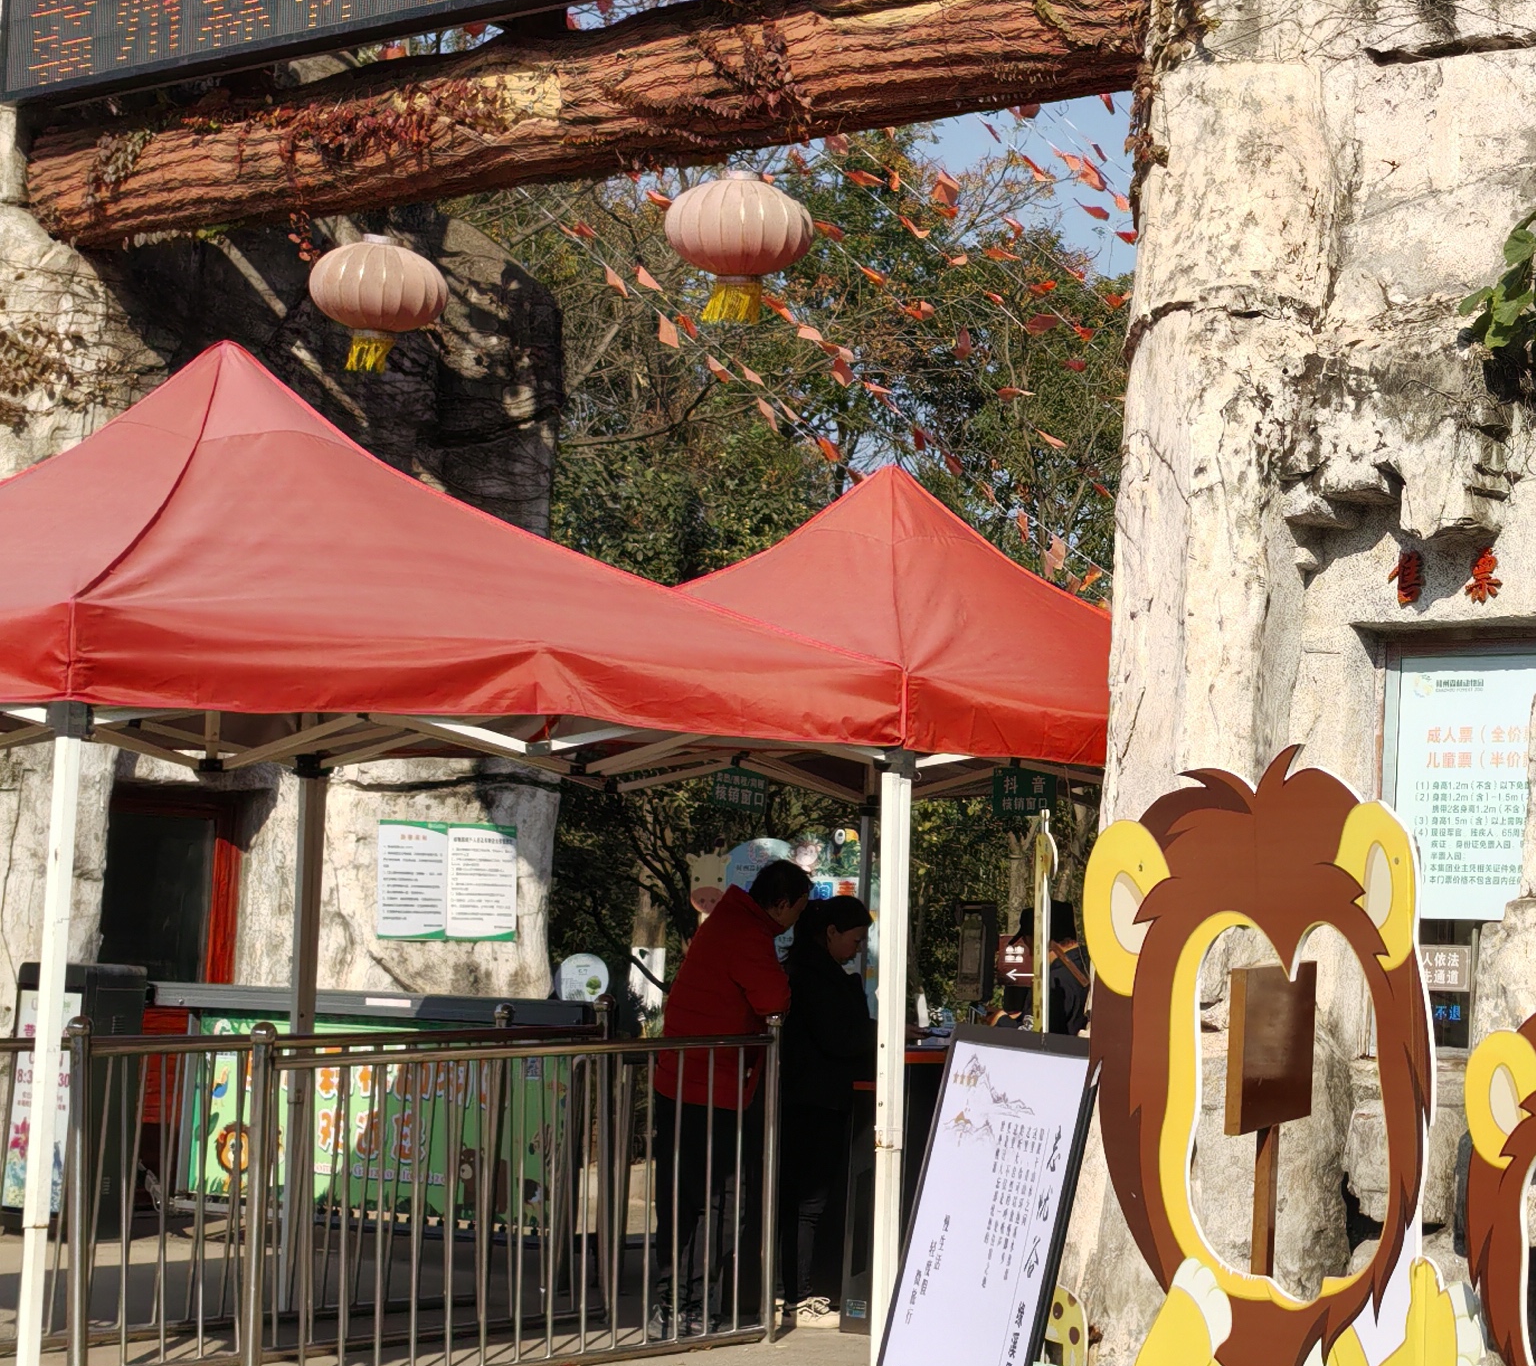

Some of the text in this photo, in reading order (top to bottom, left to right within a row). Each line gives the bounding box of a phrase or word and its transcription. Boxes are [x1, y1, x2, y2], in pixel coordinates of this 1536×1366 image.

[1003, 775, 1046, 794] 抖音
[715, 784, 765, 806] 核销窗口
[1002, 796, 1048, 811] 核销窗口
